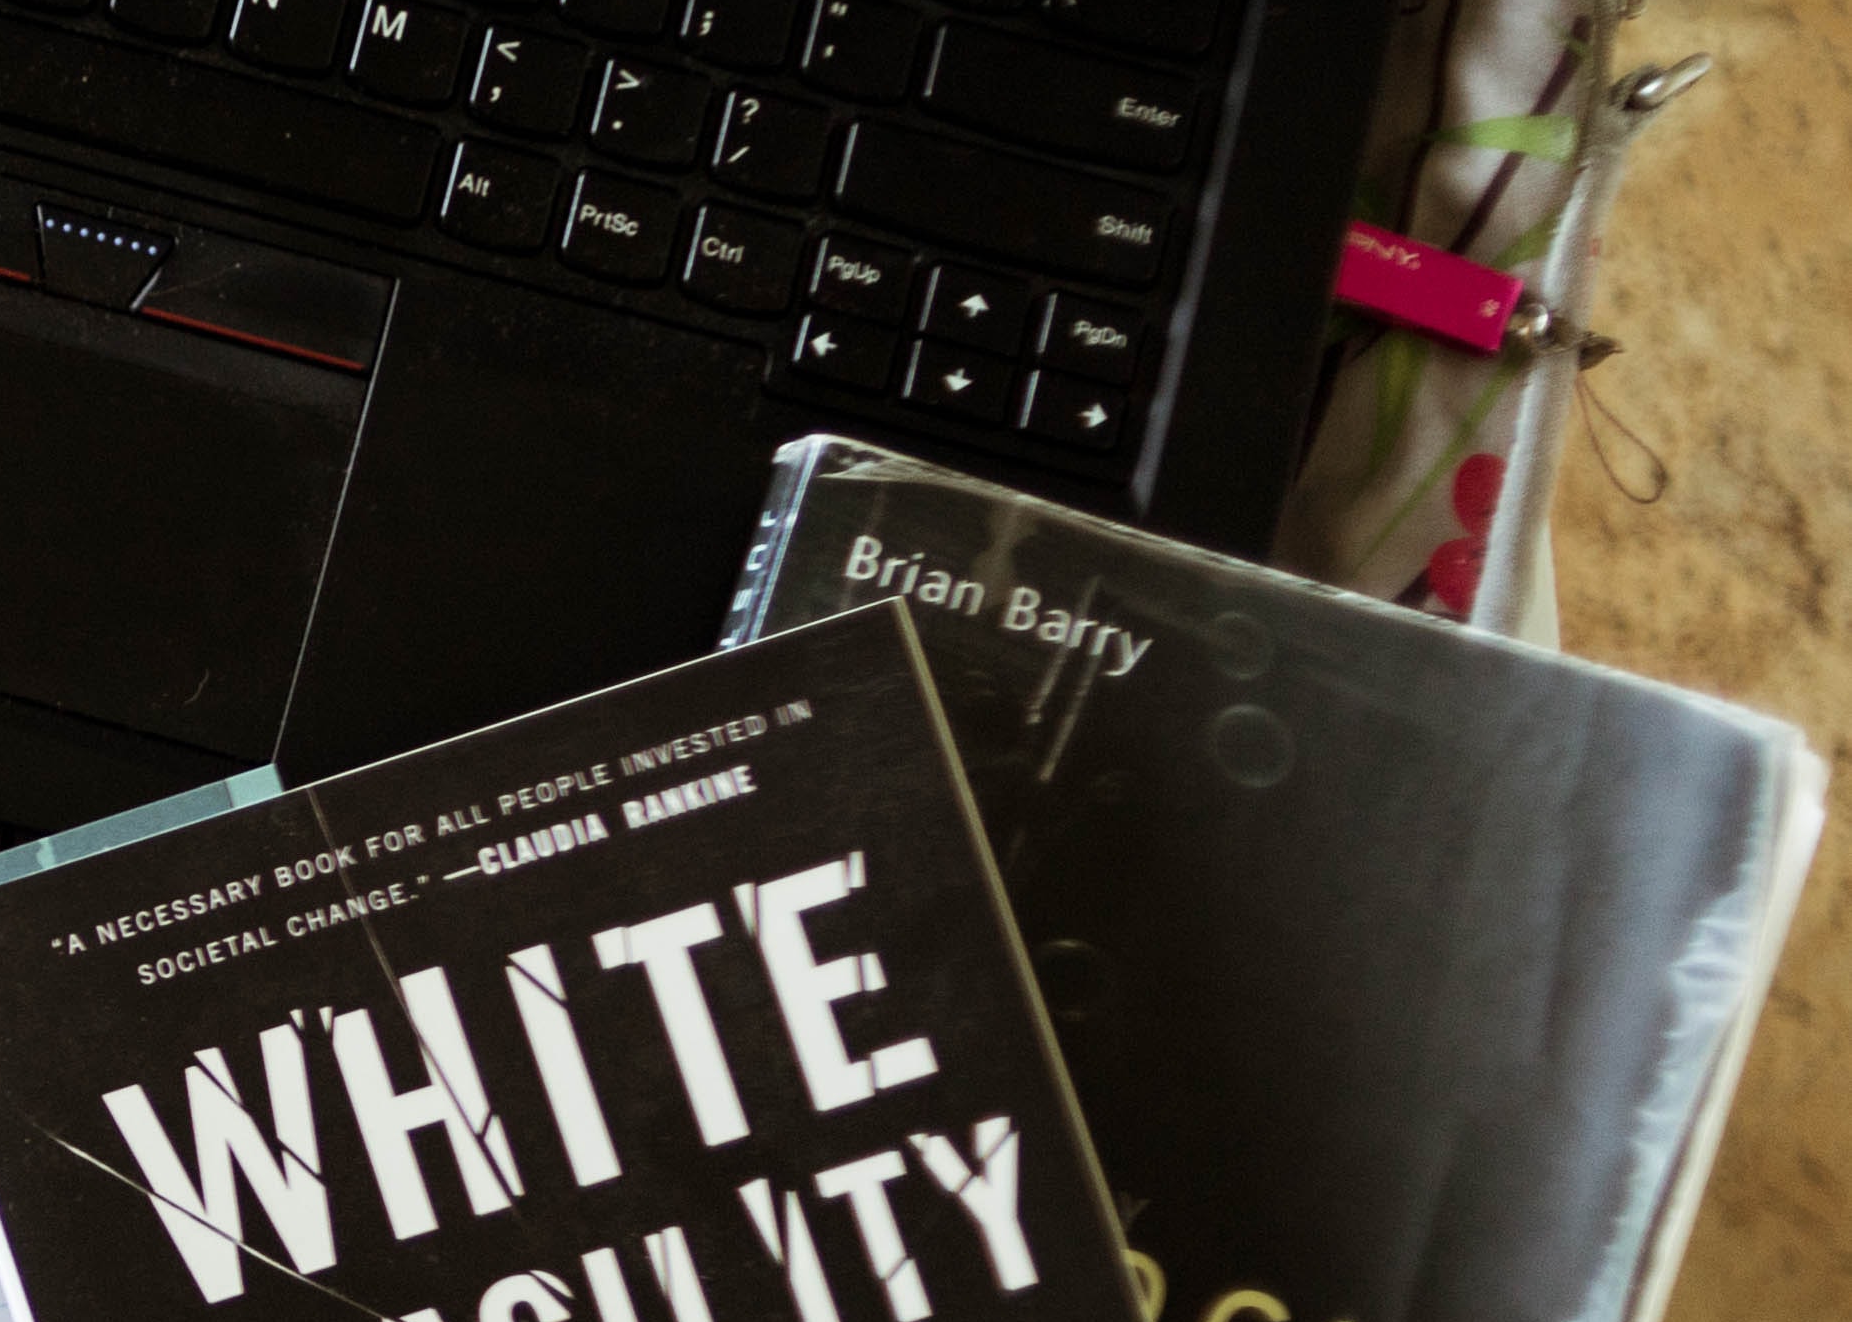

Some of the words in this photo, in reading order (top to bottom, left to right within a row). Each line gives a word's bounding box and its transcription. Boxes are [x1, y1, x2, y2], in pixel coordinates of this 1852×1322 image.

[1115, 96, 1182, 129] Enter
[458, 172, 491, 198] Alt
[578, 205, 641, 238] PrtSc
[1097, 213, 1155, 246] Shift
[701, 237, 745, 265] Ctrl
[828, 253, 882, 286] PgUp
[1072, 317, 1128, 349] PgDn
[843, 534, 986, 616] Brian
[1003, 585, 1154, 677] Barry
[96, 875, 262, 947] NECESSARY
[274, 846, 358, 888] BOOK
[365, 823, 426, 859] FOR
[436, 805, 490, 836] ALL
[498, 765, 609, 816] PEOPLE
[621, 716, 768, 777] INVESTED
[776, 701, 813, 726] IN
[137, 923, 278, 985] SOCIETAL
[623, 766, 758, 828] RANKINE
[100, 849, 941, 1304] WHITE
